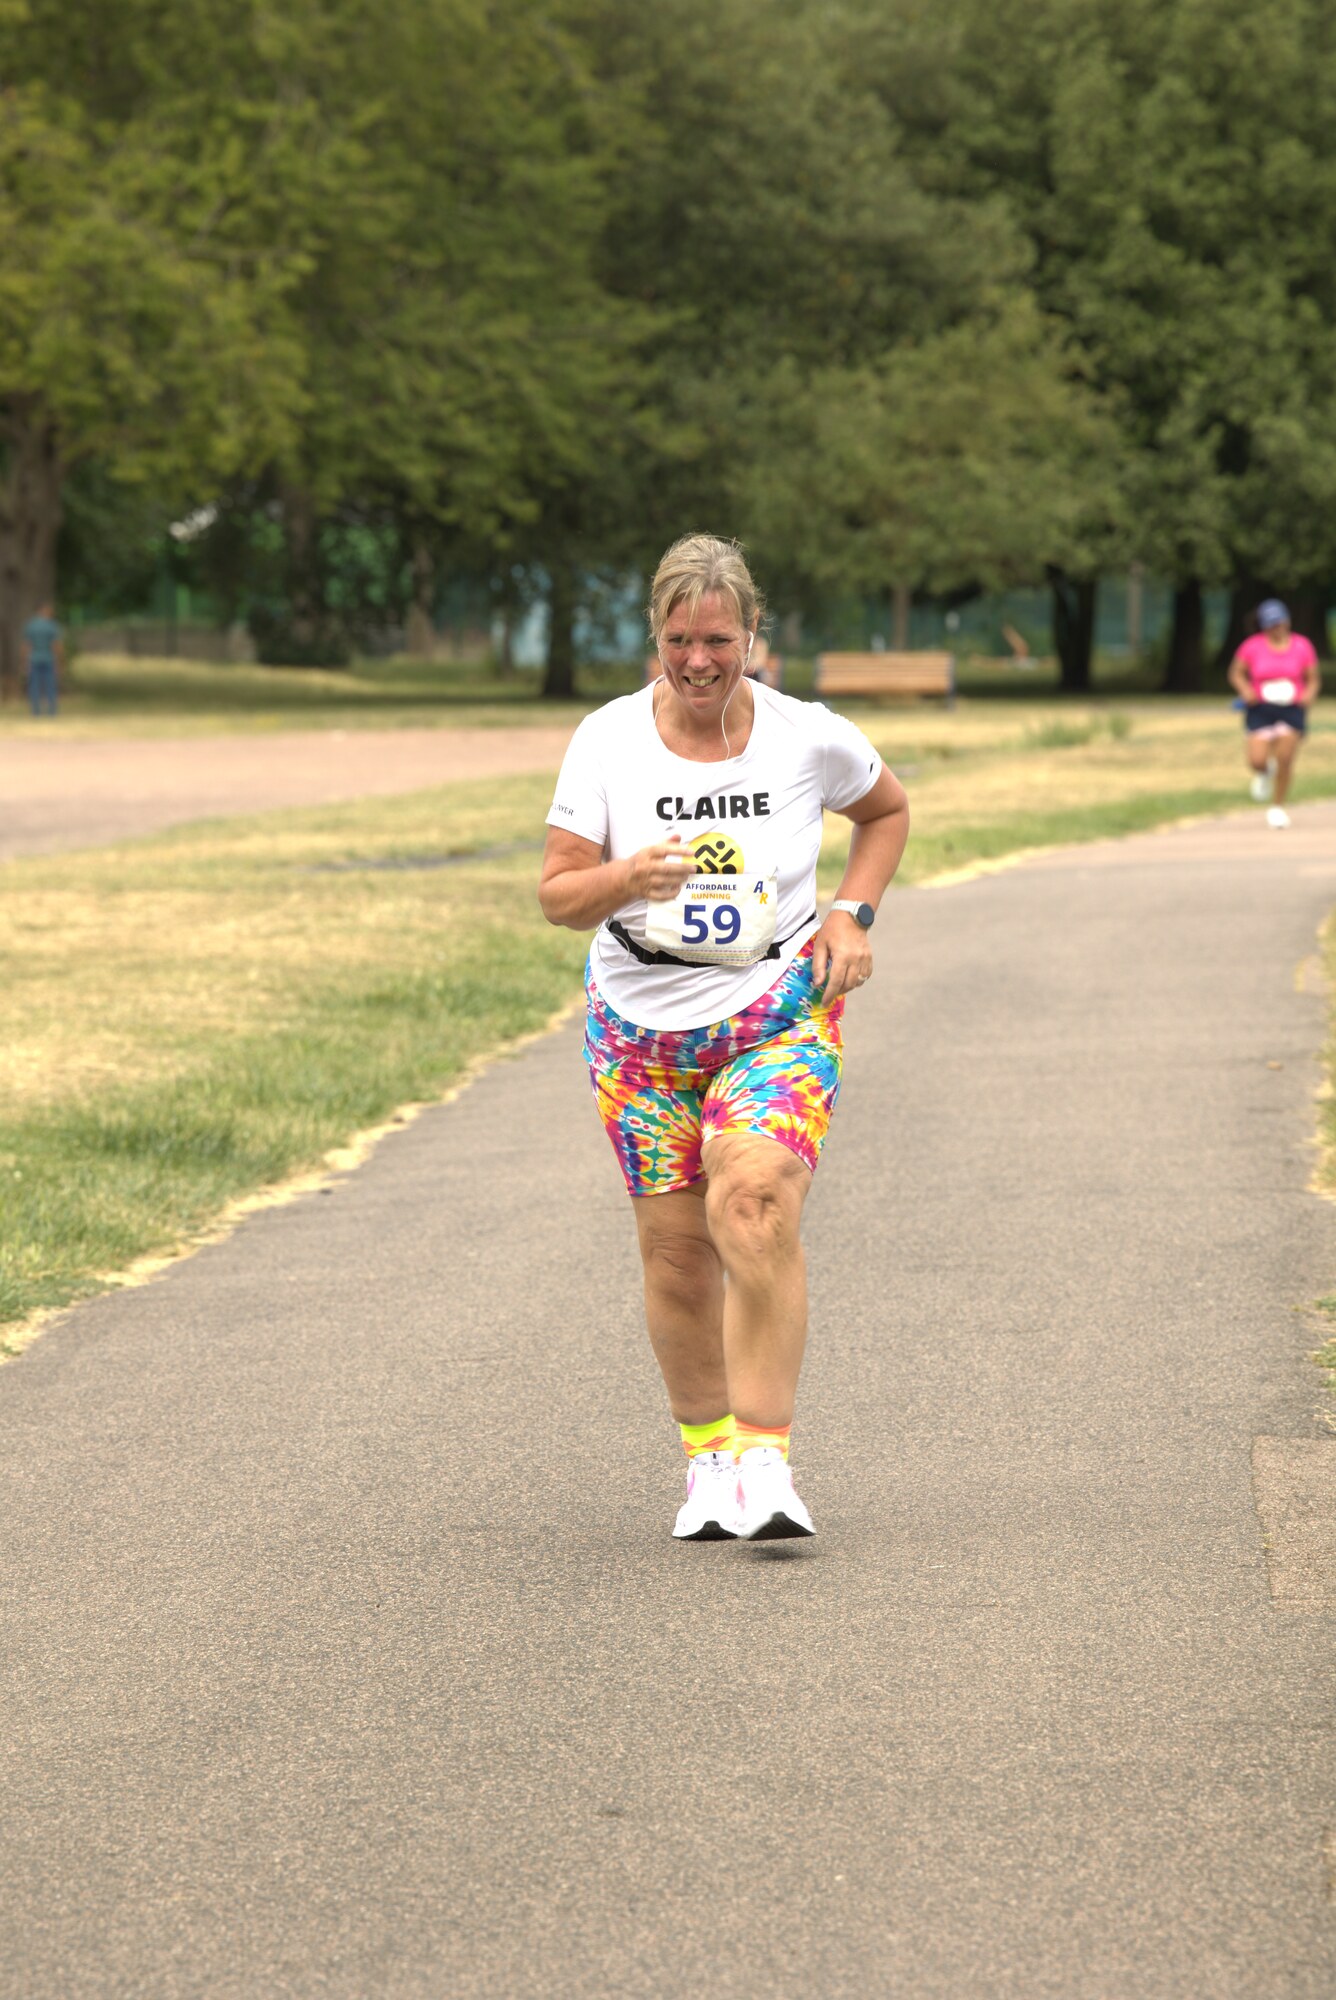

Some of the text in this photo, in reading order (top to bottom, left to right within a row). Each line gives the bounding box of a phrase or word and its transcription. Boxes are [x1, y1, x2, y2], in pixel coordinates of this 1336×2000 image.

[656, 792, 770, 821] CLAIRE
[685, 883, 737, 891] AFFORDABLE
[691, 892, 731, 900] RUNNING
[681, 904, 741, 945] 59
